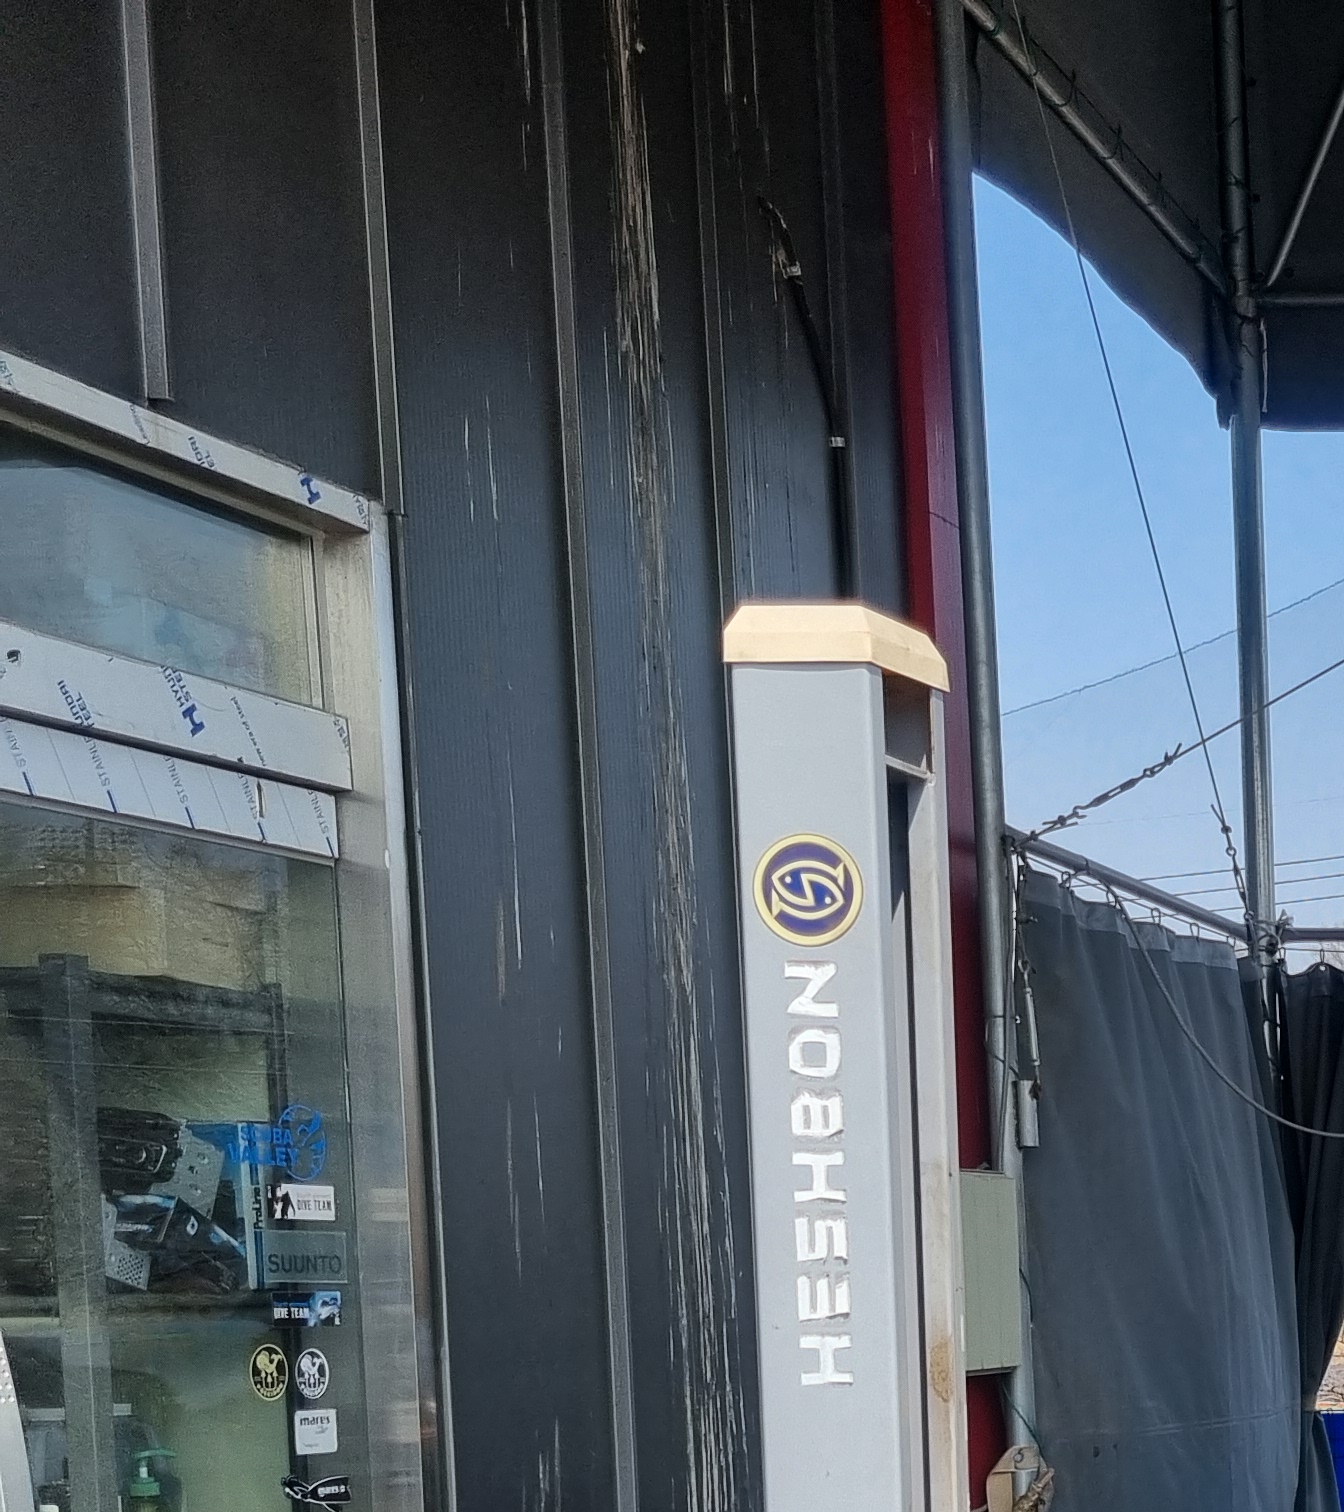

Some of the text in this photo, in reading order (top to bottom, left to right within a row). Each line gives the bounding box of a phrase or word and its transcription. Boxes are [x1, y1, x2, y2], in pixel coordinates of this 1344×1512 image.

[784, 959, 854, 1387] HESHBON
[268, 1254, 341, 1274] SUUNTO
[300, 1416, 331, 1427] mares
